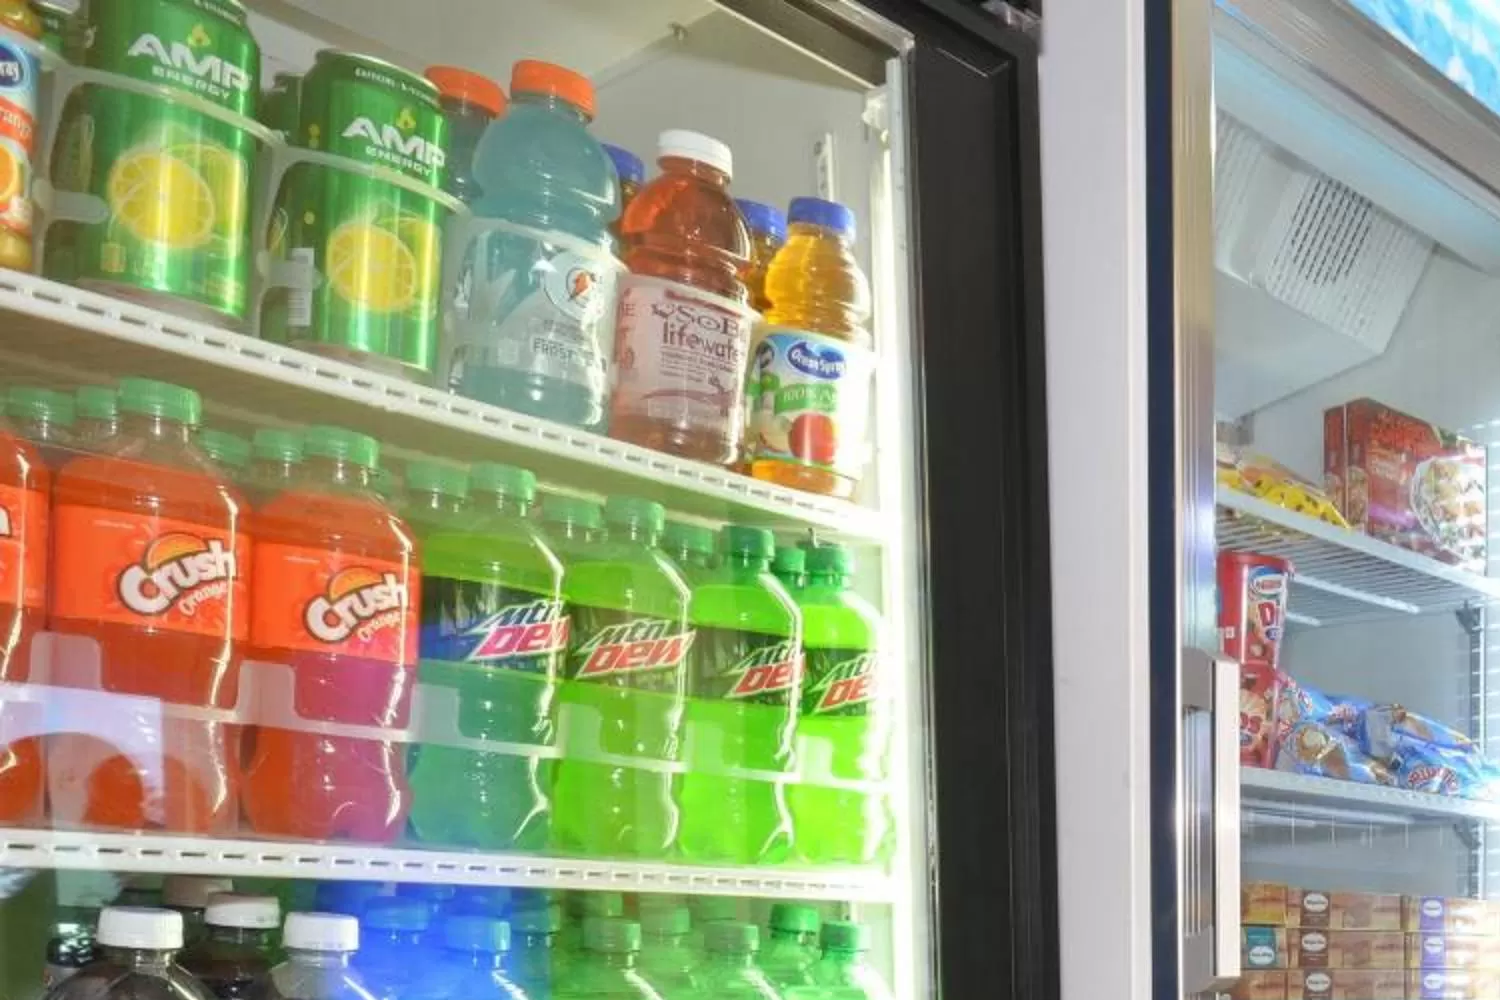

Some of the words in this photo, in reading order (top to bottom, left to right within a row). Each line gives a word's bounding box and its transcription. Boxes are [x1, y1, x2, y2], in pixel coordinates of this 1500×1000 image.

[128, 34, 248, 91] AMP
[152, 65, 230, 99] ENERGY
[341, 117, 445, 168] AMP
[365, 145, 432, 176] ENERGY
[120, 540, 236, 612] Crush
[306, 574, 408, 641] Crush
